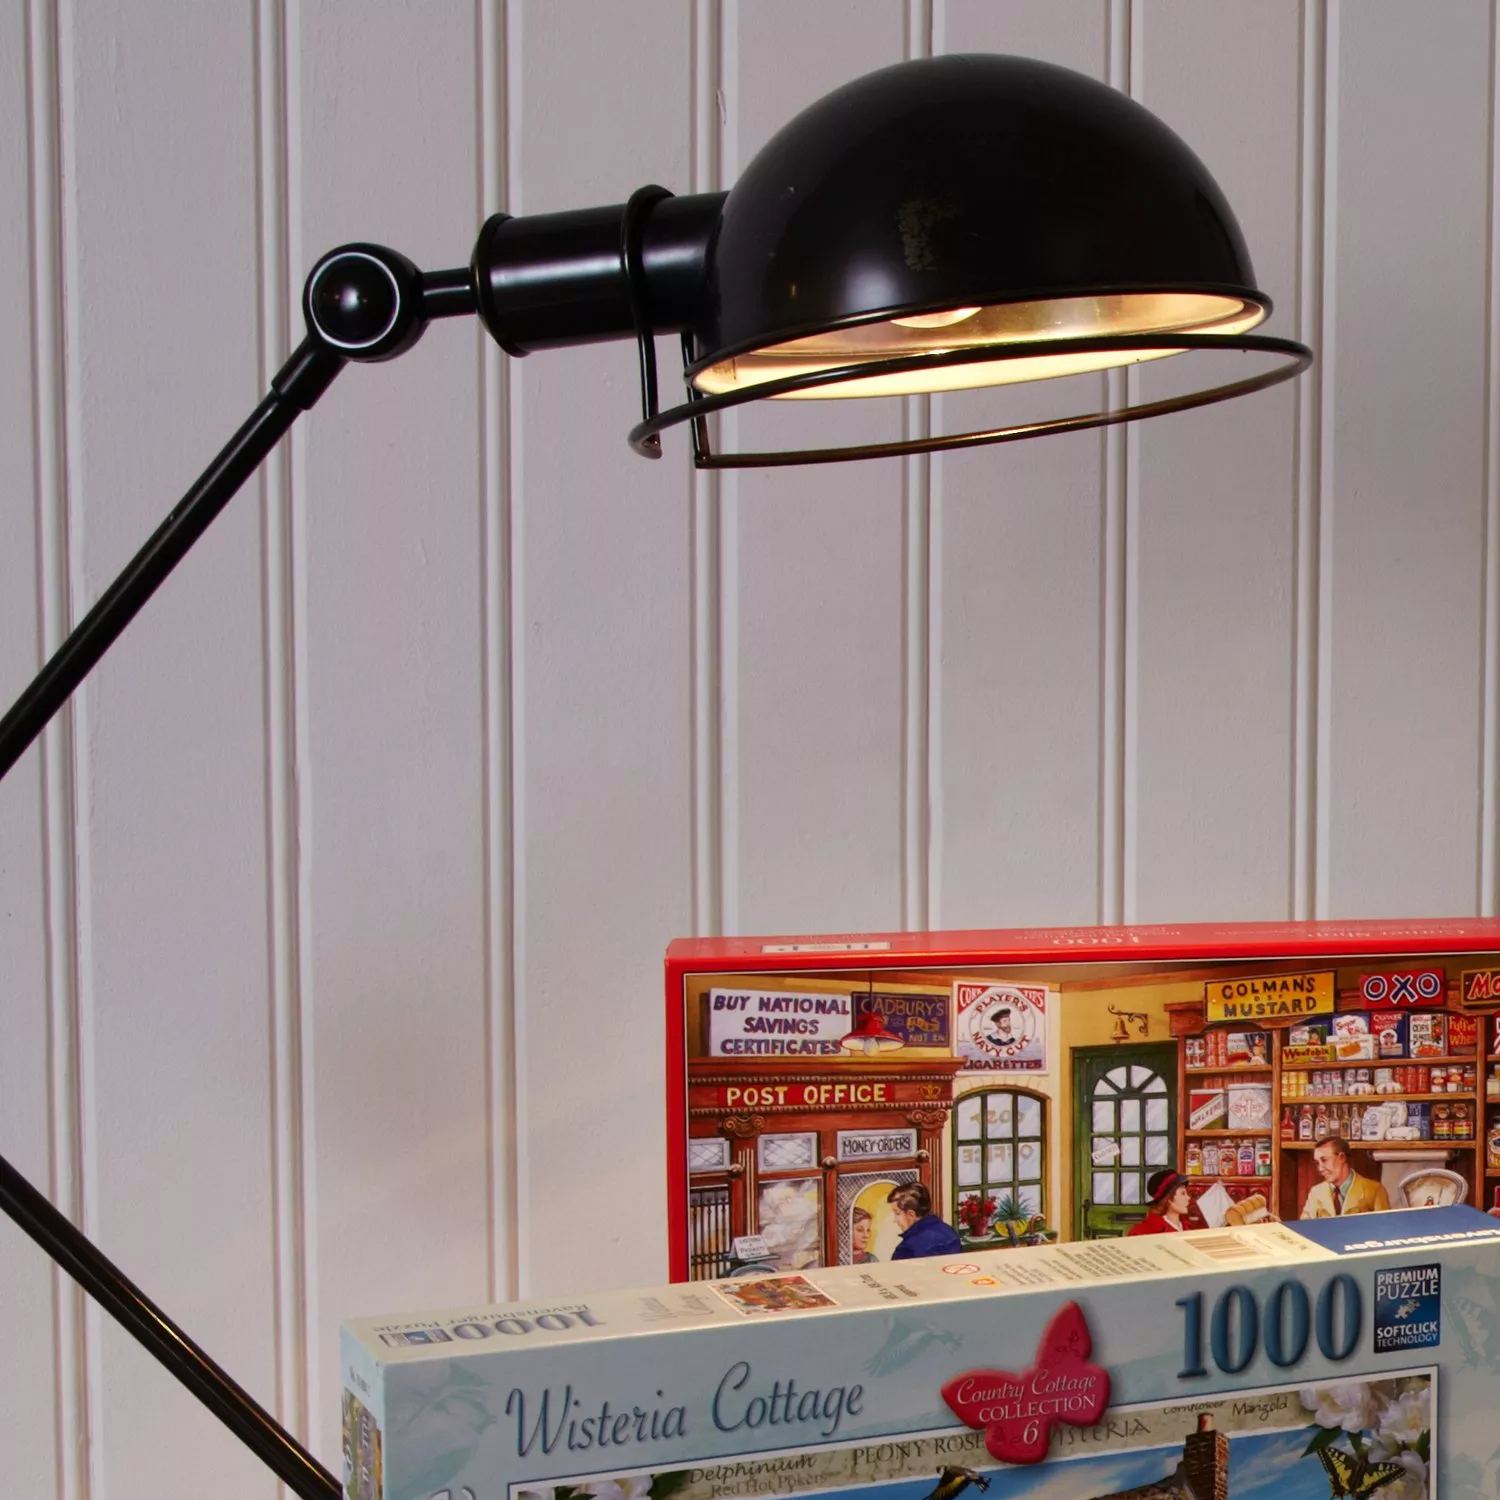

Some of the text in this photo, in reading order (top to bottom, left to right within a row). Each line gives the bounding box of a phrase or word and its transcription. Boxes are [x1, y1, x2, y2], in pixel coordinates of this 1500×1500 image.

[1363, 972, 1440, 1004] OXO
[713, 994, 850, 1015] BUY NATIONAL
[860, 998, 945, 1016] CADBURY'S
[1224, 996, 1317, 1017] MUSTARD
[743, 1017, 819, 1035] SAVINGS
[720, 1038, 841, 1054] CERTIFICATES
[973, 1031, 1031, 1057] NAVY CUT
[727, 1083, 887, 1106] POST OFFICE
[1377, 1266, 1439, 1287] PREMIUM
[1376, 1278, 1439, 1301] PUZZLE
[453, 1311, 607, 1340] 1000
[1176, 1273, 1363, 1379] 1000
[1377, 1320, 1438, 1339] SOFTCLICK
[1377, 1332, 1438, 1348] TECHNOLOGY
[956, 1368, 1098, 1406] Country Cottage
[505, 1361, 865, 1458] Wisteria Cottage
[978, 1392, 1097, 1424] COLLECTION
[1231, 1400, 1289, 1422] Marigold
[1022, 1419, 1039, 1446] 6
[852, 1438, 928, 1466] PEONY
[689, 1453, 817, 1485] Delphinium
[711, 1479, 741, 1499] Red
[746, 1476, 774, 1495] Hot
